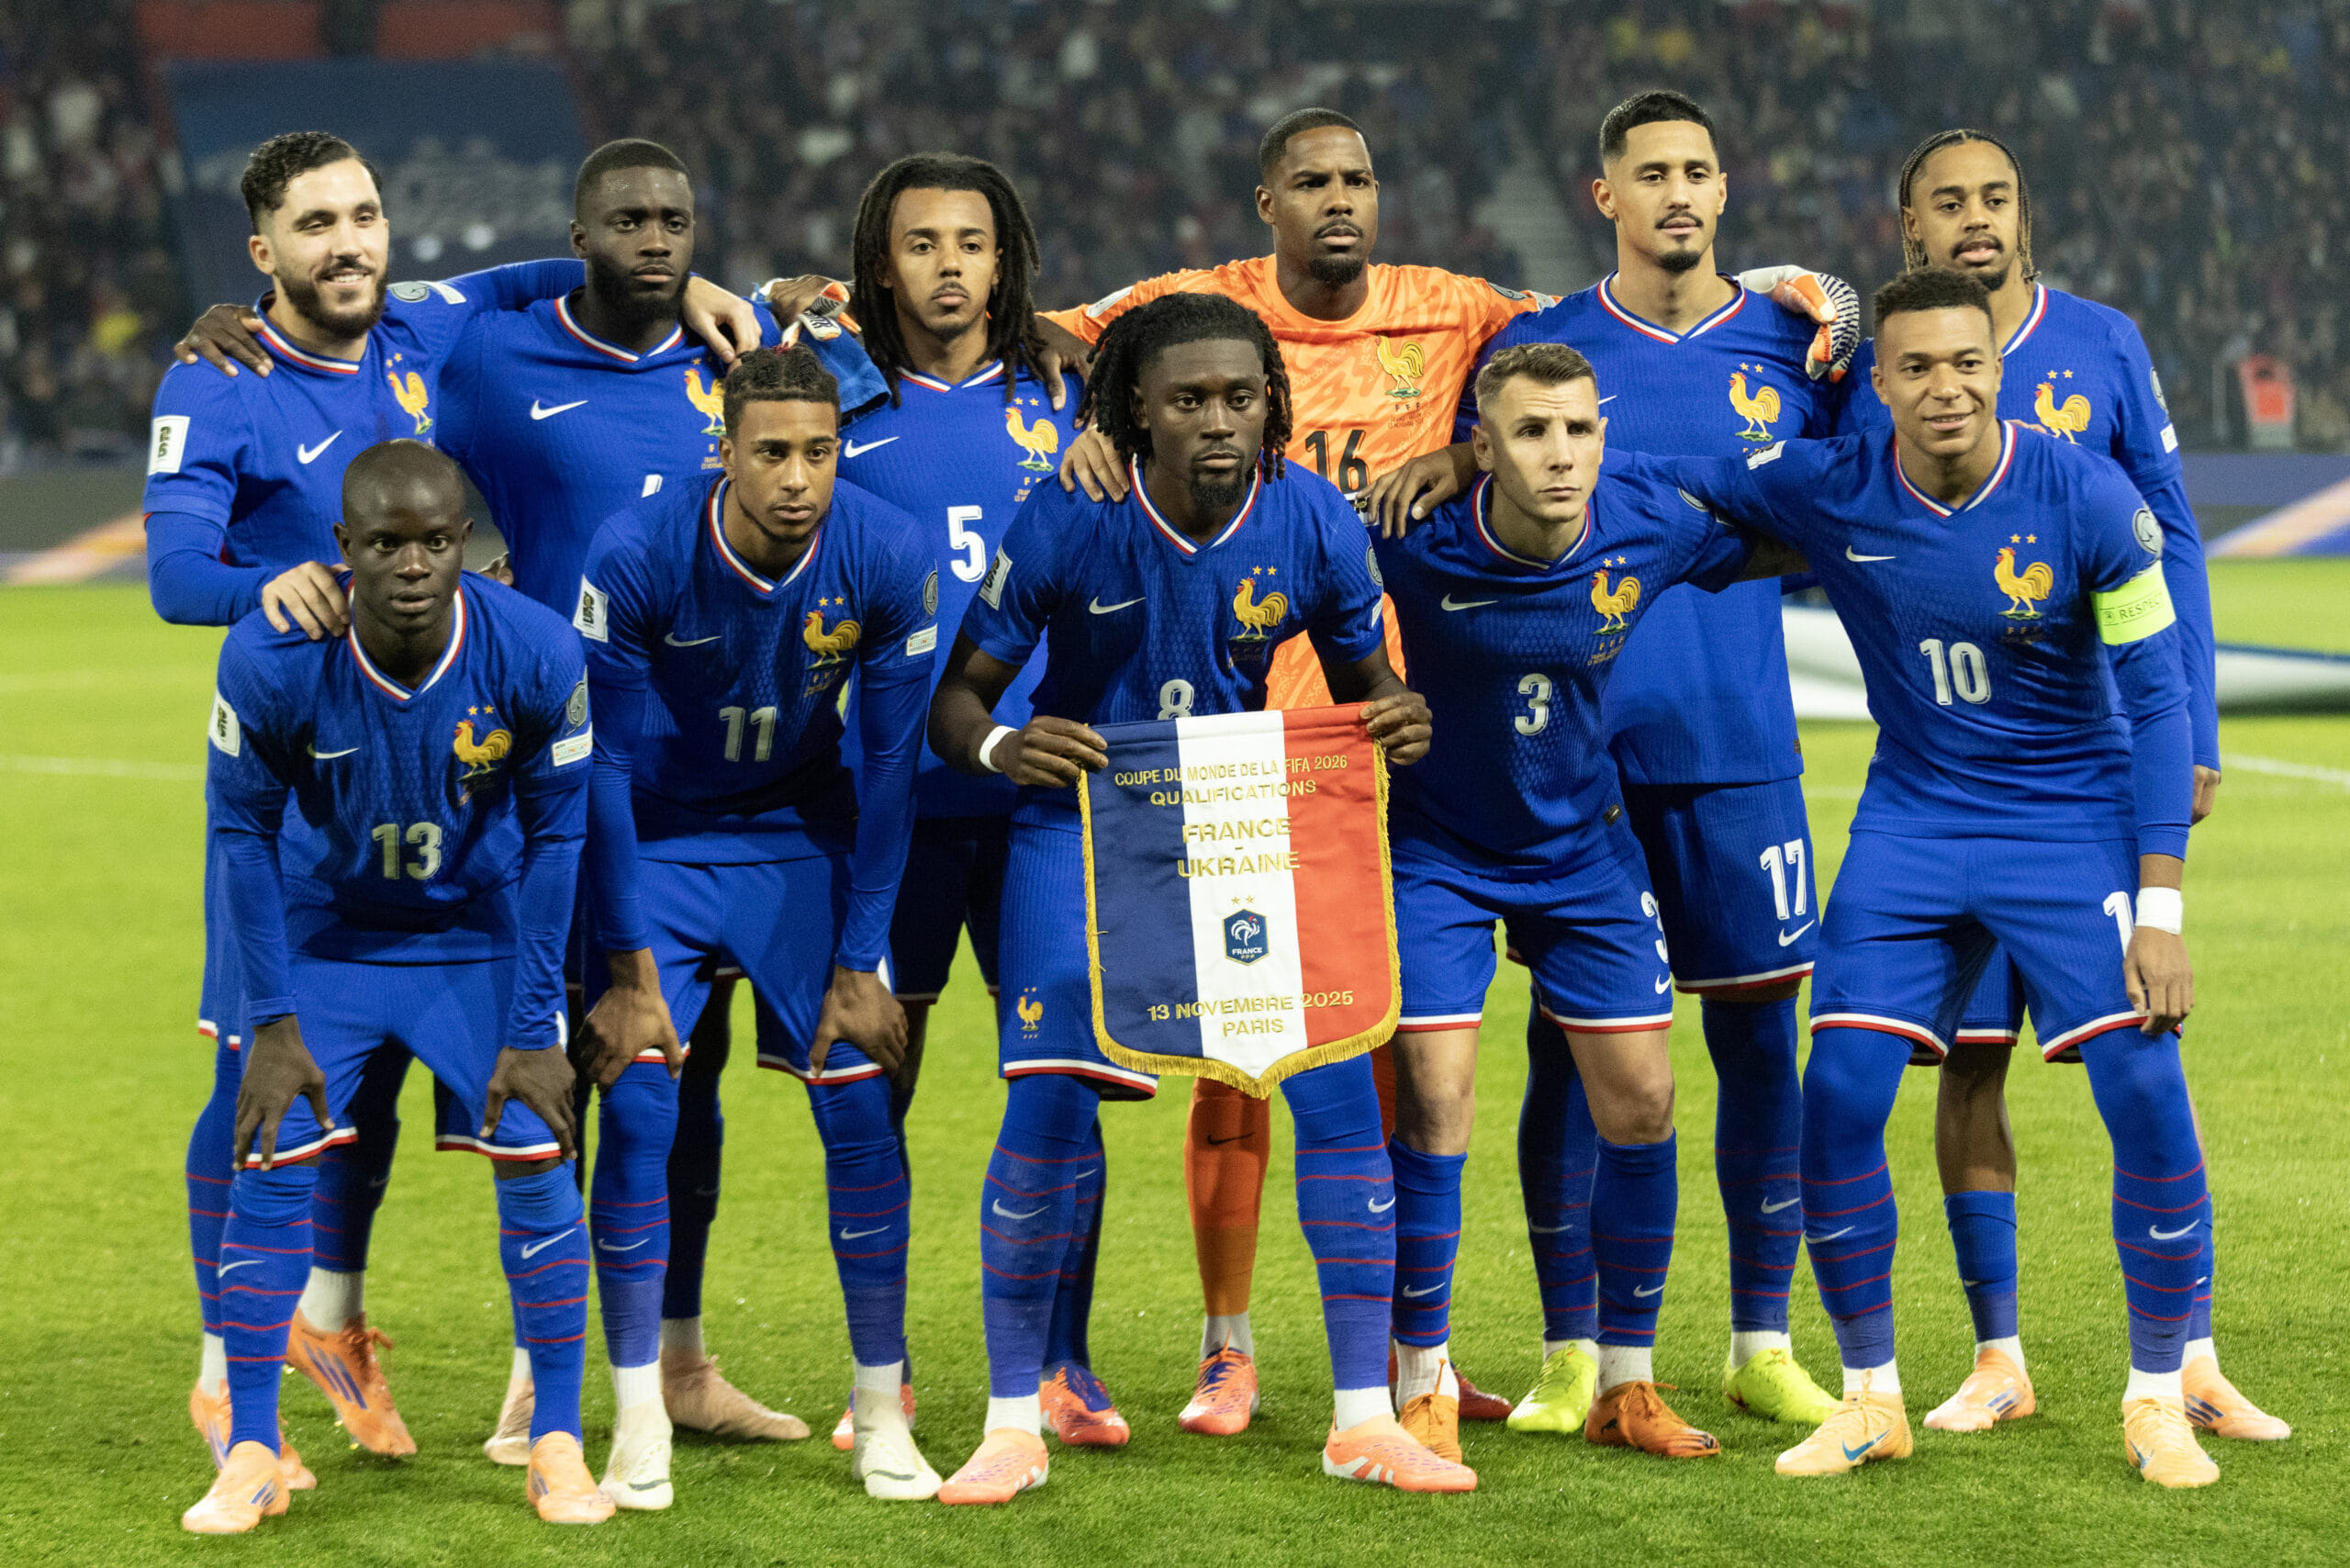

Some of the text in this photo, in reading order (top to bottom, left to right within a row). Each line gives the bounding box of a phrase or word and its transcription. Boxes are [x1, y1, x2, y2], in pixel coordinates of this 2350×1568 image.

[1305, 429, 1371, 494] 16
[946, 505, 987, 583] 5
[1157, 678, 1195, 721] 8
[1919, 638, 1992, 706] 10
[1514, 672, 1553, 736] 3
[718, 705, 778, 763] 11
[1114, 755, 1348, 786] COUPE DU MONDE DE LA FIFA 2026
[1149, 779, 1317, 806] QUALIFICATIONS
[371, 822, 442, 880] 13
[1181, 816, 1293, 844] FRANCE
[1177, 851, 1301, 879] UKRAINE
[1759, 837, 1807, 921] 17
[1232, 946, 1263, 956] FRANCE
[1640, 890, 1669, 964] 3
[2102, 890, 2135, 959] 1
[1147, 991, 1355, 1021] 13 NOVEMBRE 2025
[1222, 1018, 1285, 1037] PARIS
